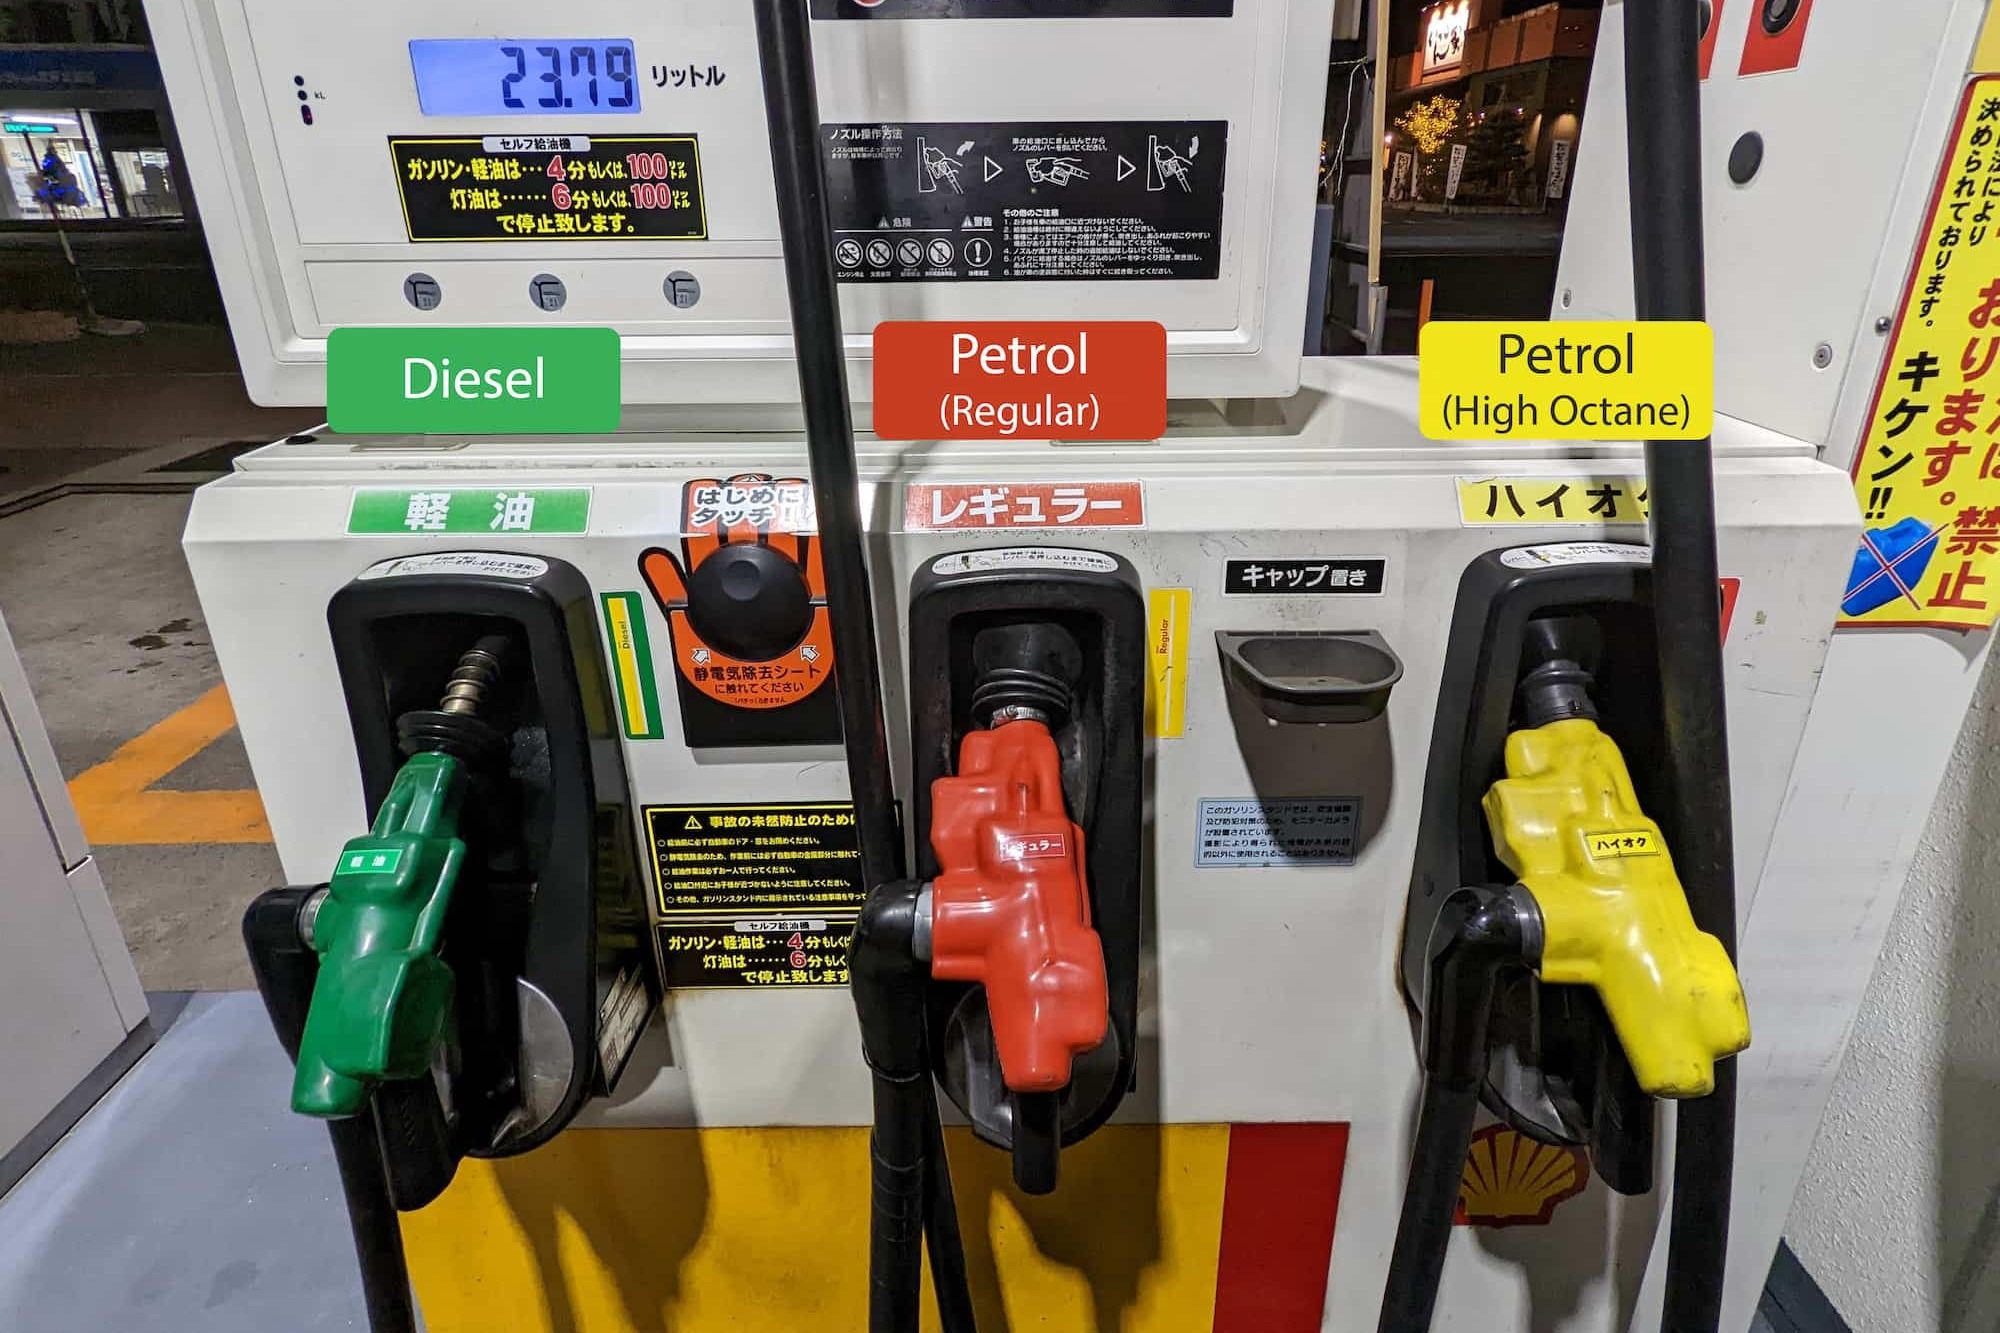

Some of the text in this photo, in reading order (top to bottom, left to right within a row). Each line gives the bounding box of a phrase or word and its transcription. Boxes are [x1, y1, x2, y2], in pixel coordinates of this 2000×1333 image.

[500, 46, 633, 108] 23.79
[651, 65, 726, 88] リットル
[499, 137, 572, 151] セルフ給油機
[496, 214, 637, 233] で停止致します。
[973, 216, 993, 227] 警告
[1922, 226, 2000, 506] おります。
[696, 487, 800, 505] はじめに
[931, 486, 1124, 525] レギュラー
[403, 492, 536, 532] 軽油
[1241, 564, 1367, 588] キャップ置き
[619, 621, 631, 649] Diesel
[1159, 619, 1169, 655] Regular
[693, 665, 821, 682] 静電気除去シート
[714, 682, 805, 694] に触れてください
[1006, 840, 1061, 852] ギュラー
[1597, 837, 1647, 850] ハイオク
